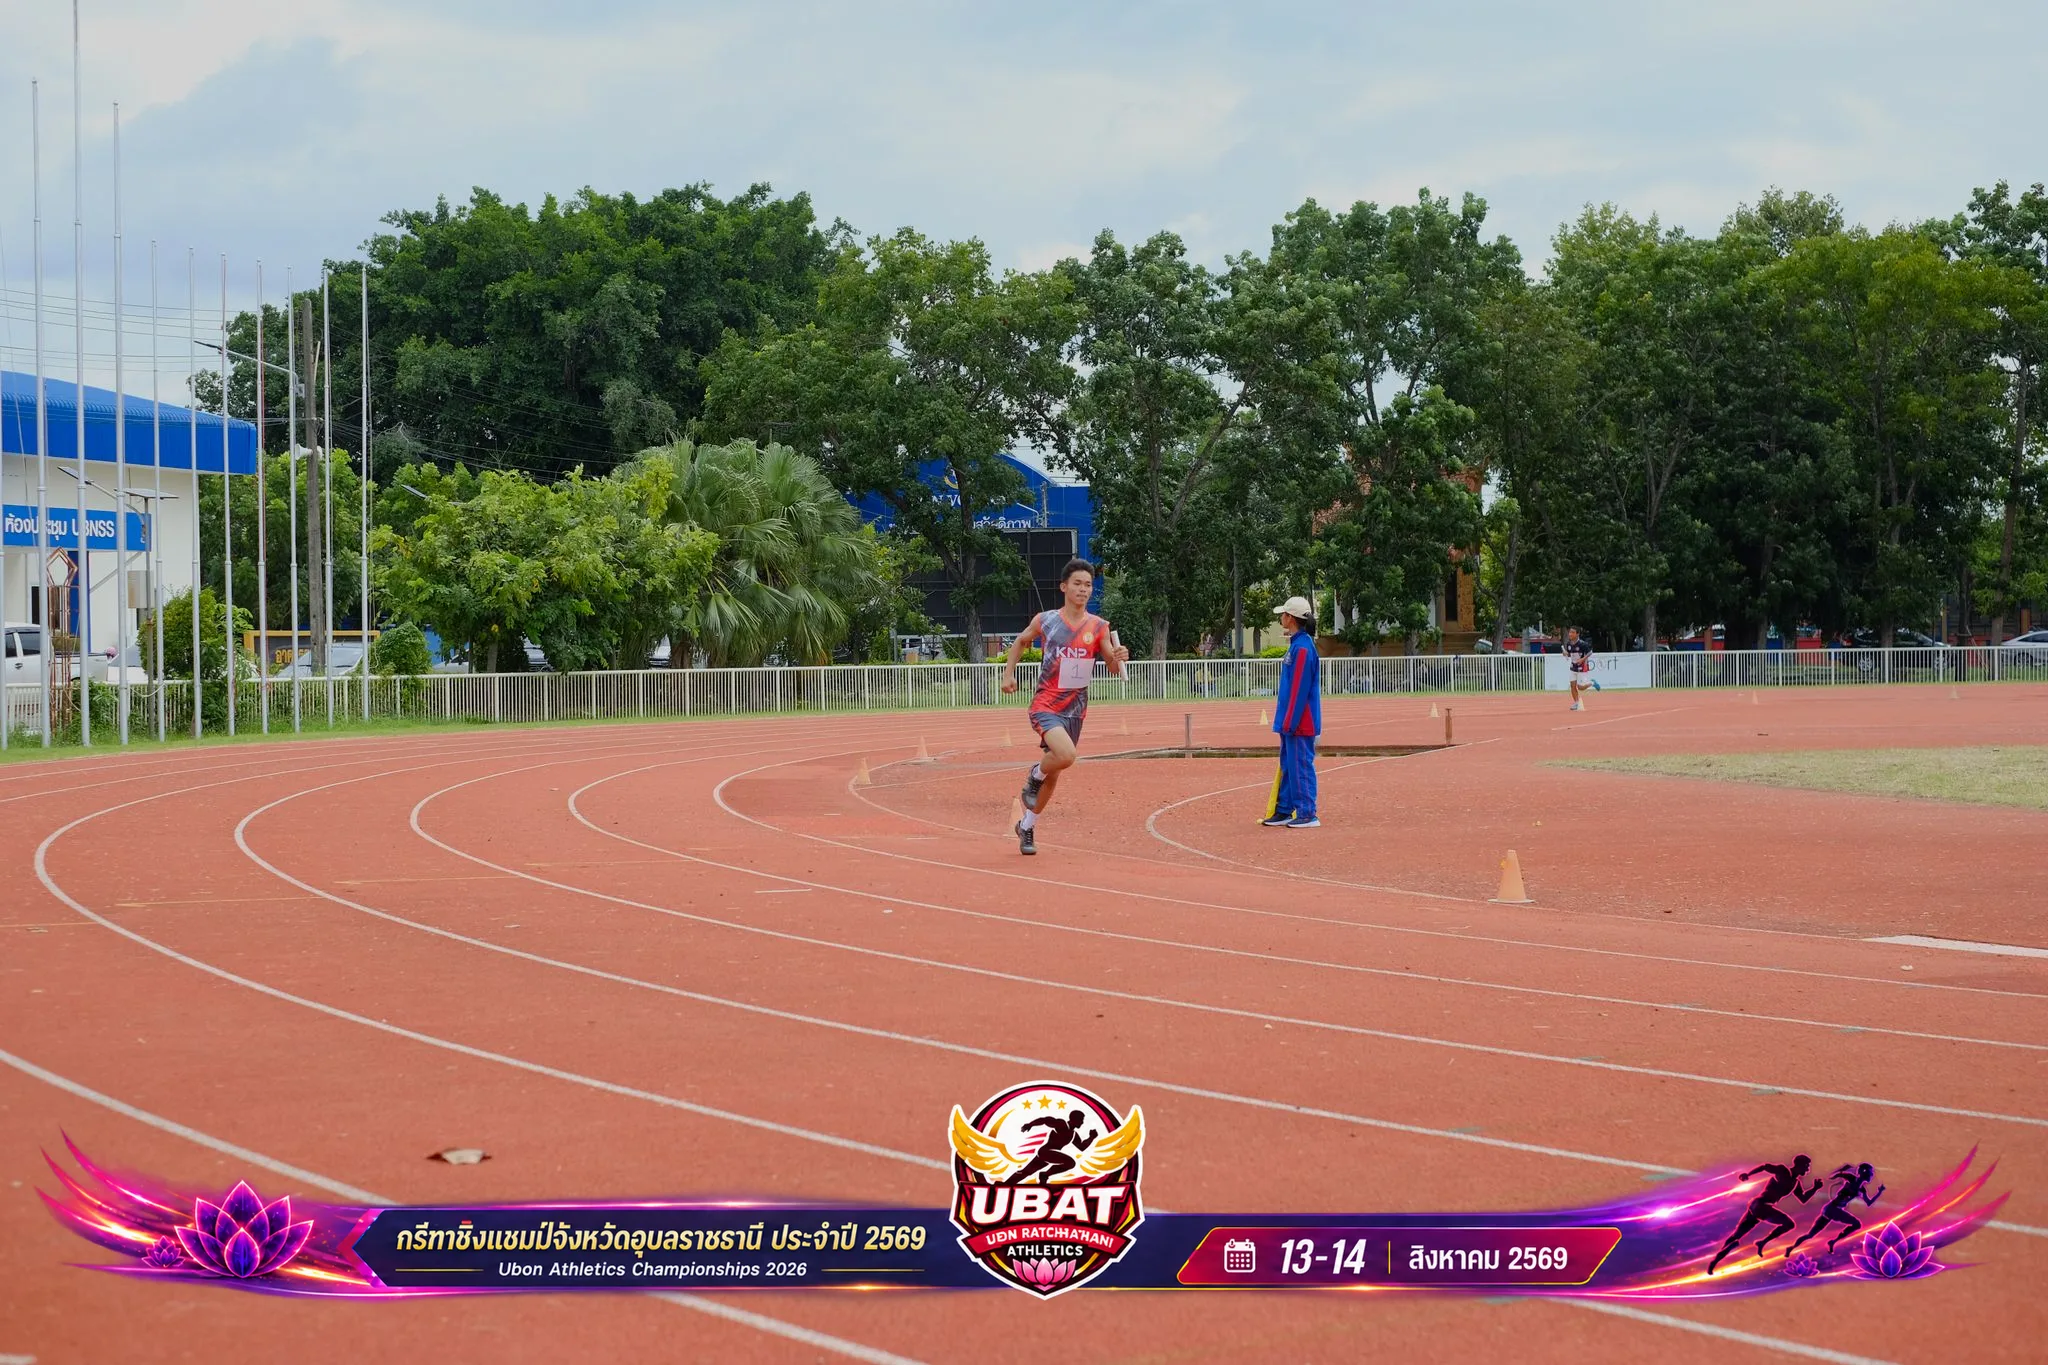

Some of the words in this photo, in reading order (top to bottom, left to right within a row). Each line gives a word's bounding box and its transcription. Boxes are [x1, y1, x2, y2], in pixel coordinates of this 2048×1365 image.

[5, 513, 67, 541] ห้องปะชุม
[1056, 646, 1087, 658] KNP
[1071, 664, 1084, 679] 1
